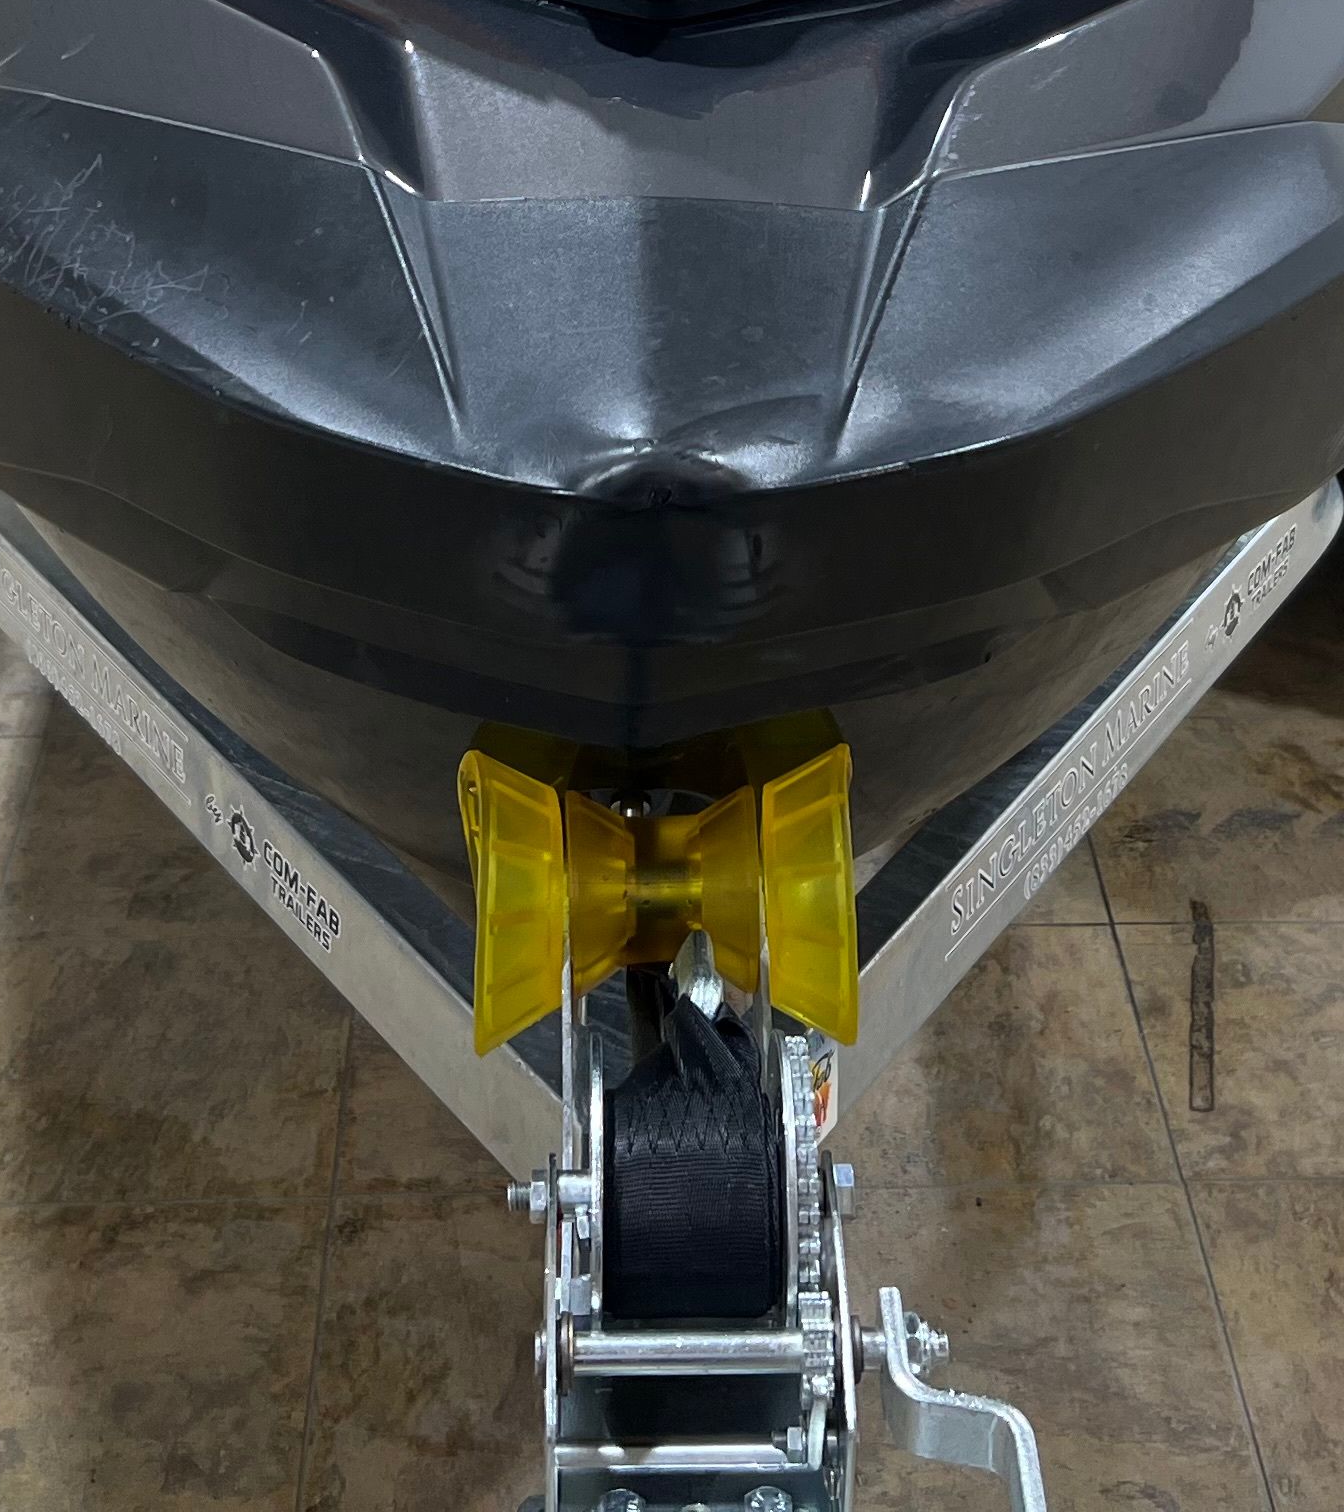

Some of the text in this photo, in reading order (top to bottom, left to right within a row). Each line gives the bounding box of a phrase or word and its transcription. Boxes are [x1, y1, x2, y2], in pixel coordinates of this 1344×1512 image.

[92, 653, 187, 784] MARINE
[950, 640, 1190, 936] SINGLETON MARINE
[263, 838, 342, 938] COM-FAB
[270, 873, 332, 954] TRAILERS
